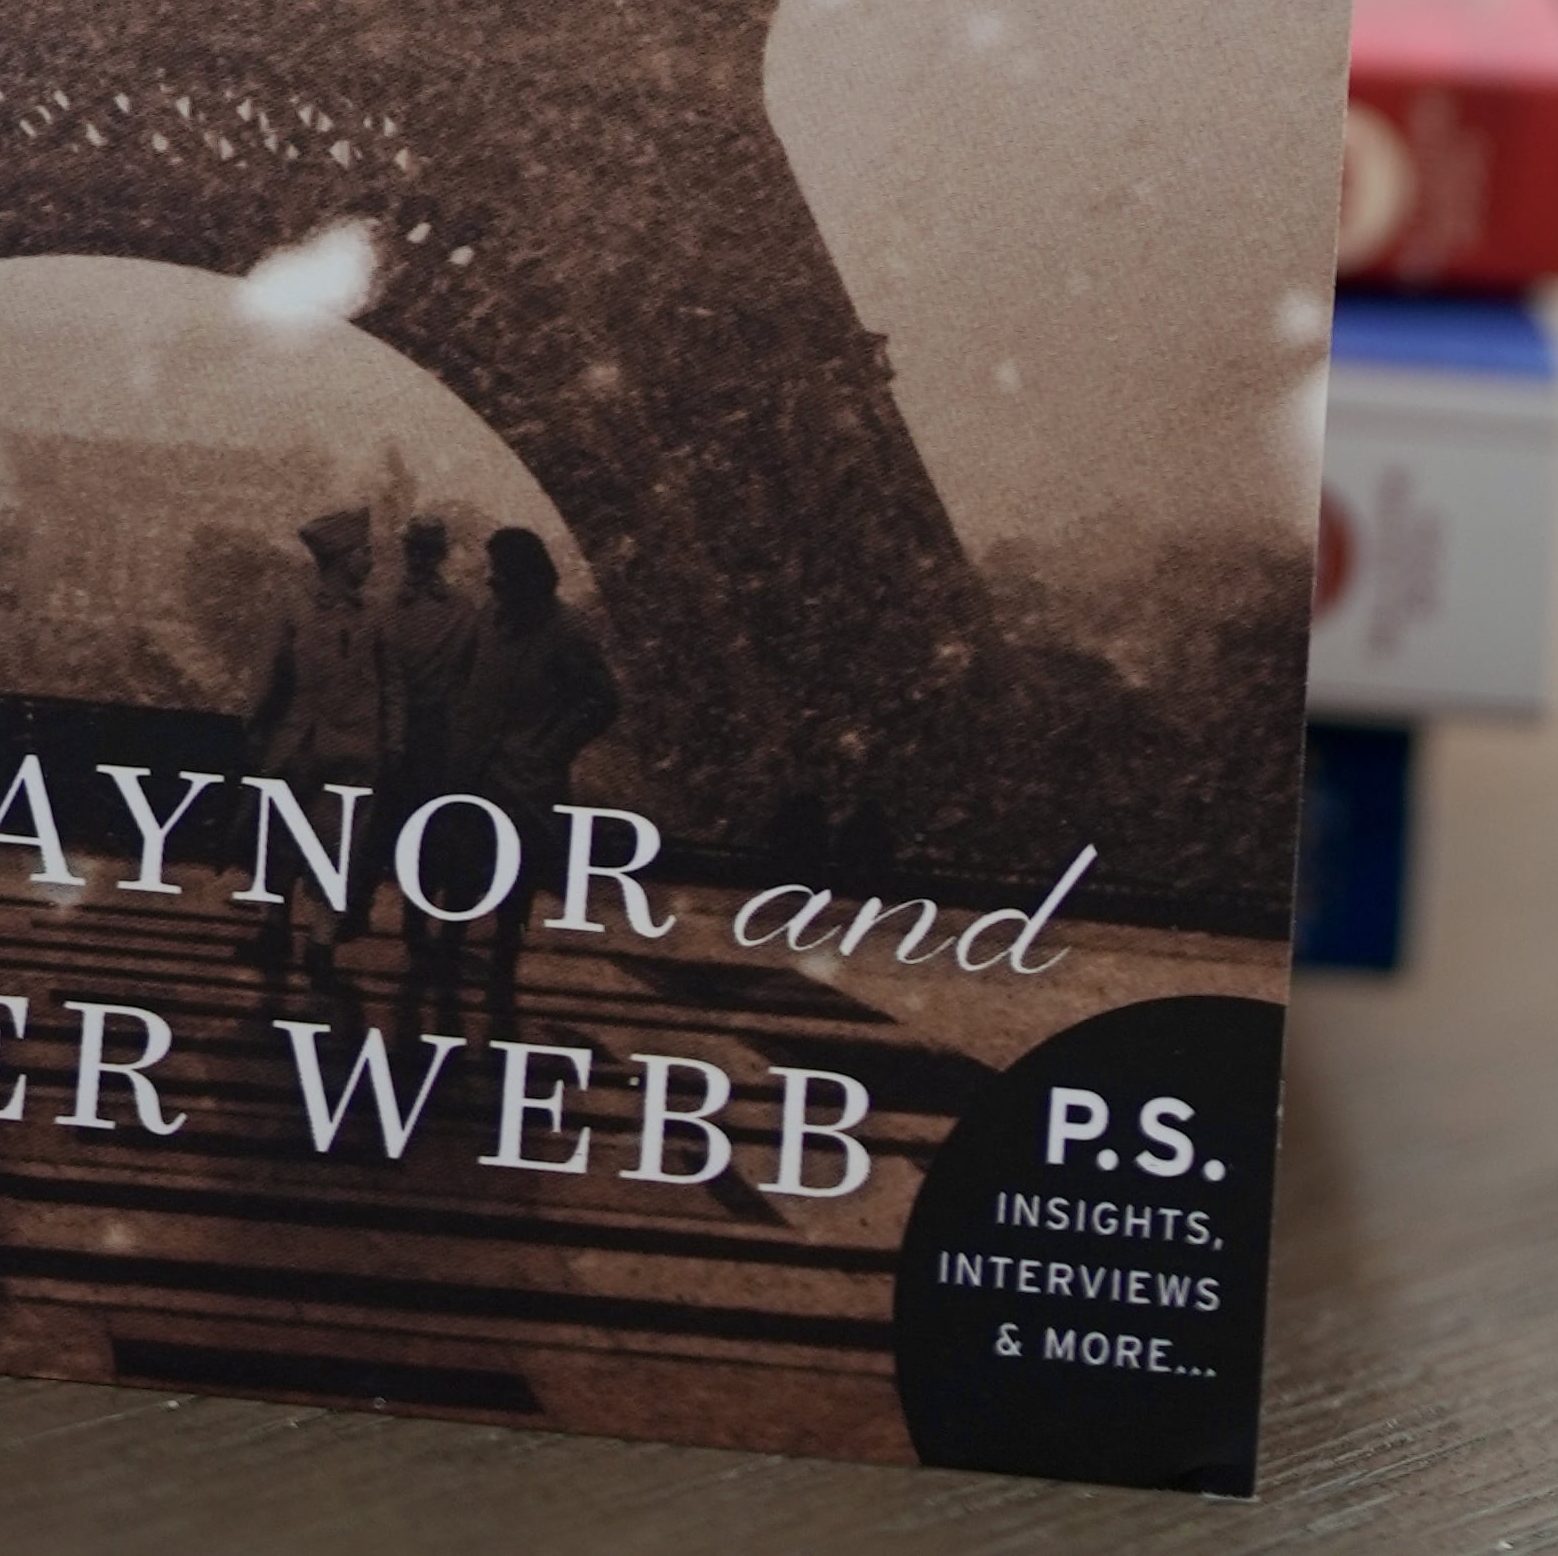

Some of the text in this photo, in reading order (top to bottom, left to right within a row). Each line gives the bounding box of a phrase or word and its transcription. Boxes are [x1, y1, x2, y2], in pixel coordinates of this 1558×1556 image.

[731, 843, 1099, 986] and
[271, 1018, 873, 1199] WEBB
[1045, 1085, 1227, 1183] P.S.
[995, 1190, 1224, 1252] INSIGHTS,
[938, 1249, 1222, 1313] INTERVIEWS
[993, 1321, 1218, 1378] & MORE...
